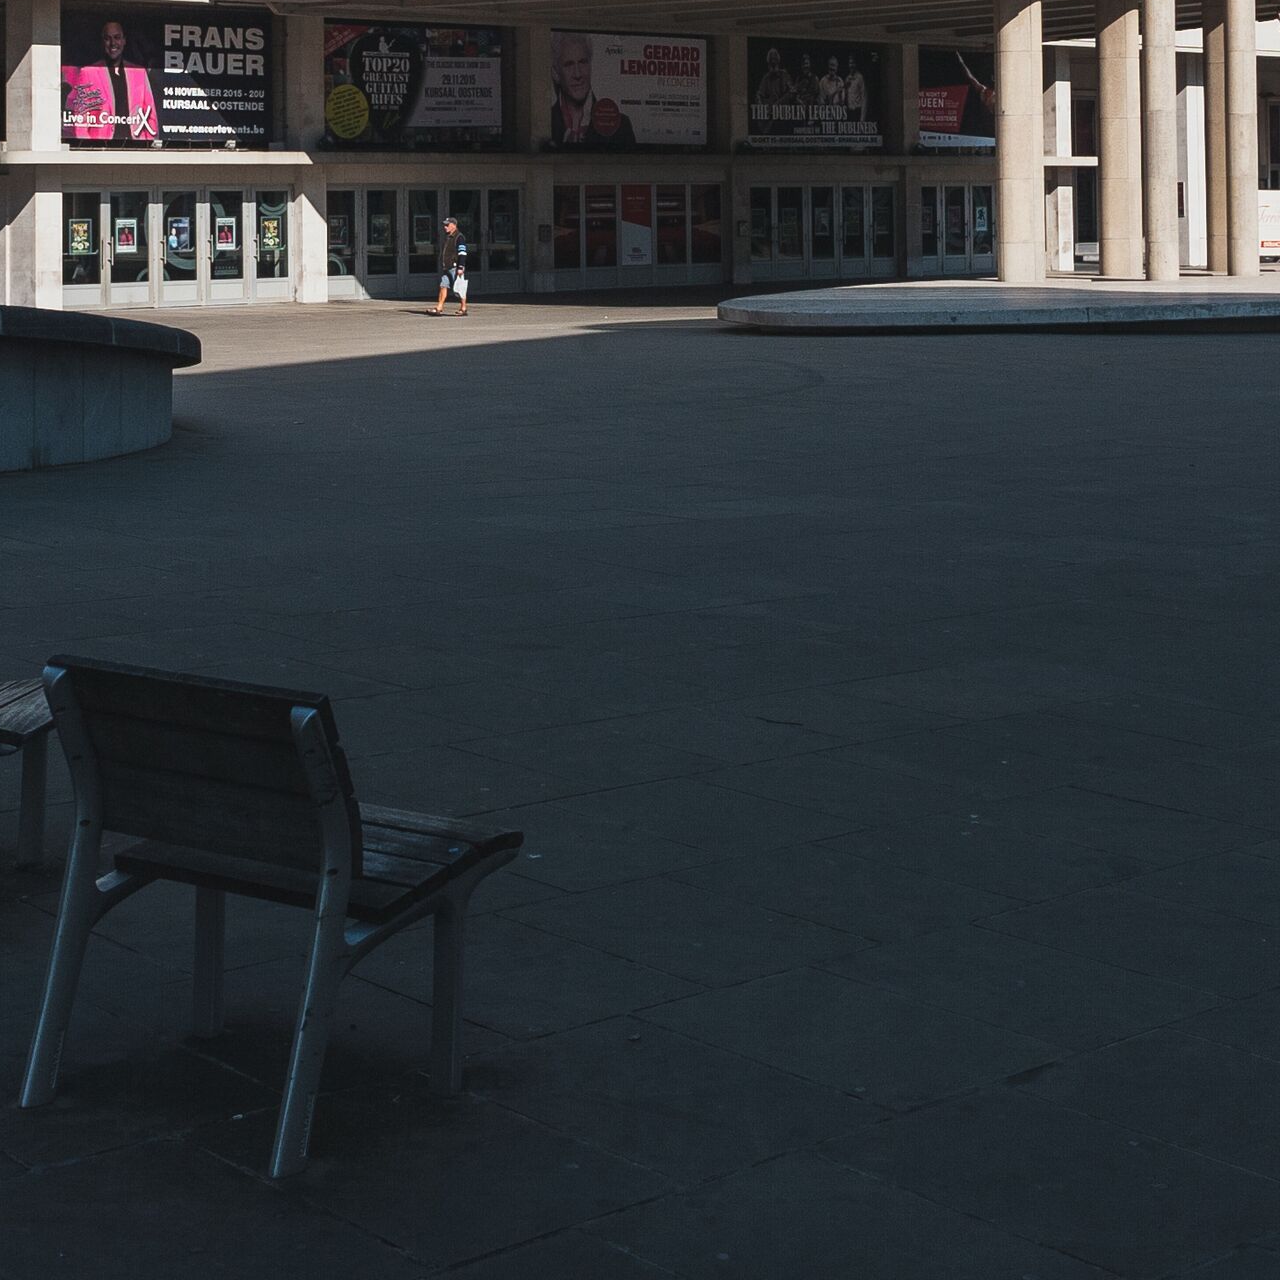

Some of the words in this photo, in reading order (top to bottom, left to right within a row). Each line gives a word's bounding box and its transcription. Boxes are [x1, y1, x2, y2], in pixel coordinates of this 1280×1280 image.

[164, 24, 265, 51] FRANS
[643, 44, 700, 62] GERARD
[164, 51, 265, 76] BAUER
[362, 57, 410, 72] TOP20
[620, 59, 700, 77] LENORMAN
[362, 72, 410, 83] GREATEST
[163, 87, 174, 96] 14
[174, 87, 222, 97] NOVEMBER
[223, 89, 242, 98] 2015
[365, 82, 408, 94] GUITAR
[424, 87, 456, 98] KURSAAL
[457, 87, 493, 98] OOSTENDE
[163, 99, 210, 111] KURSAAL
[212, 100, 265, 111] OOSTENDE
[371, 94, 404, 105] RIFFS
[919, 97, 944, 108] UEEN
[63, 111, 84, 123] Live
[86, 111, 96, 123] in
[99, 111, 140, 125] Concert
[751, 104, 769, 120] THE
[772, 104, 806, 120] DUBLIN
[809, 104, 848, 120] LEGENDS
[821, 121, 837, 134] THE
[839, 121, 878, 135] DUBLINERS
